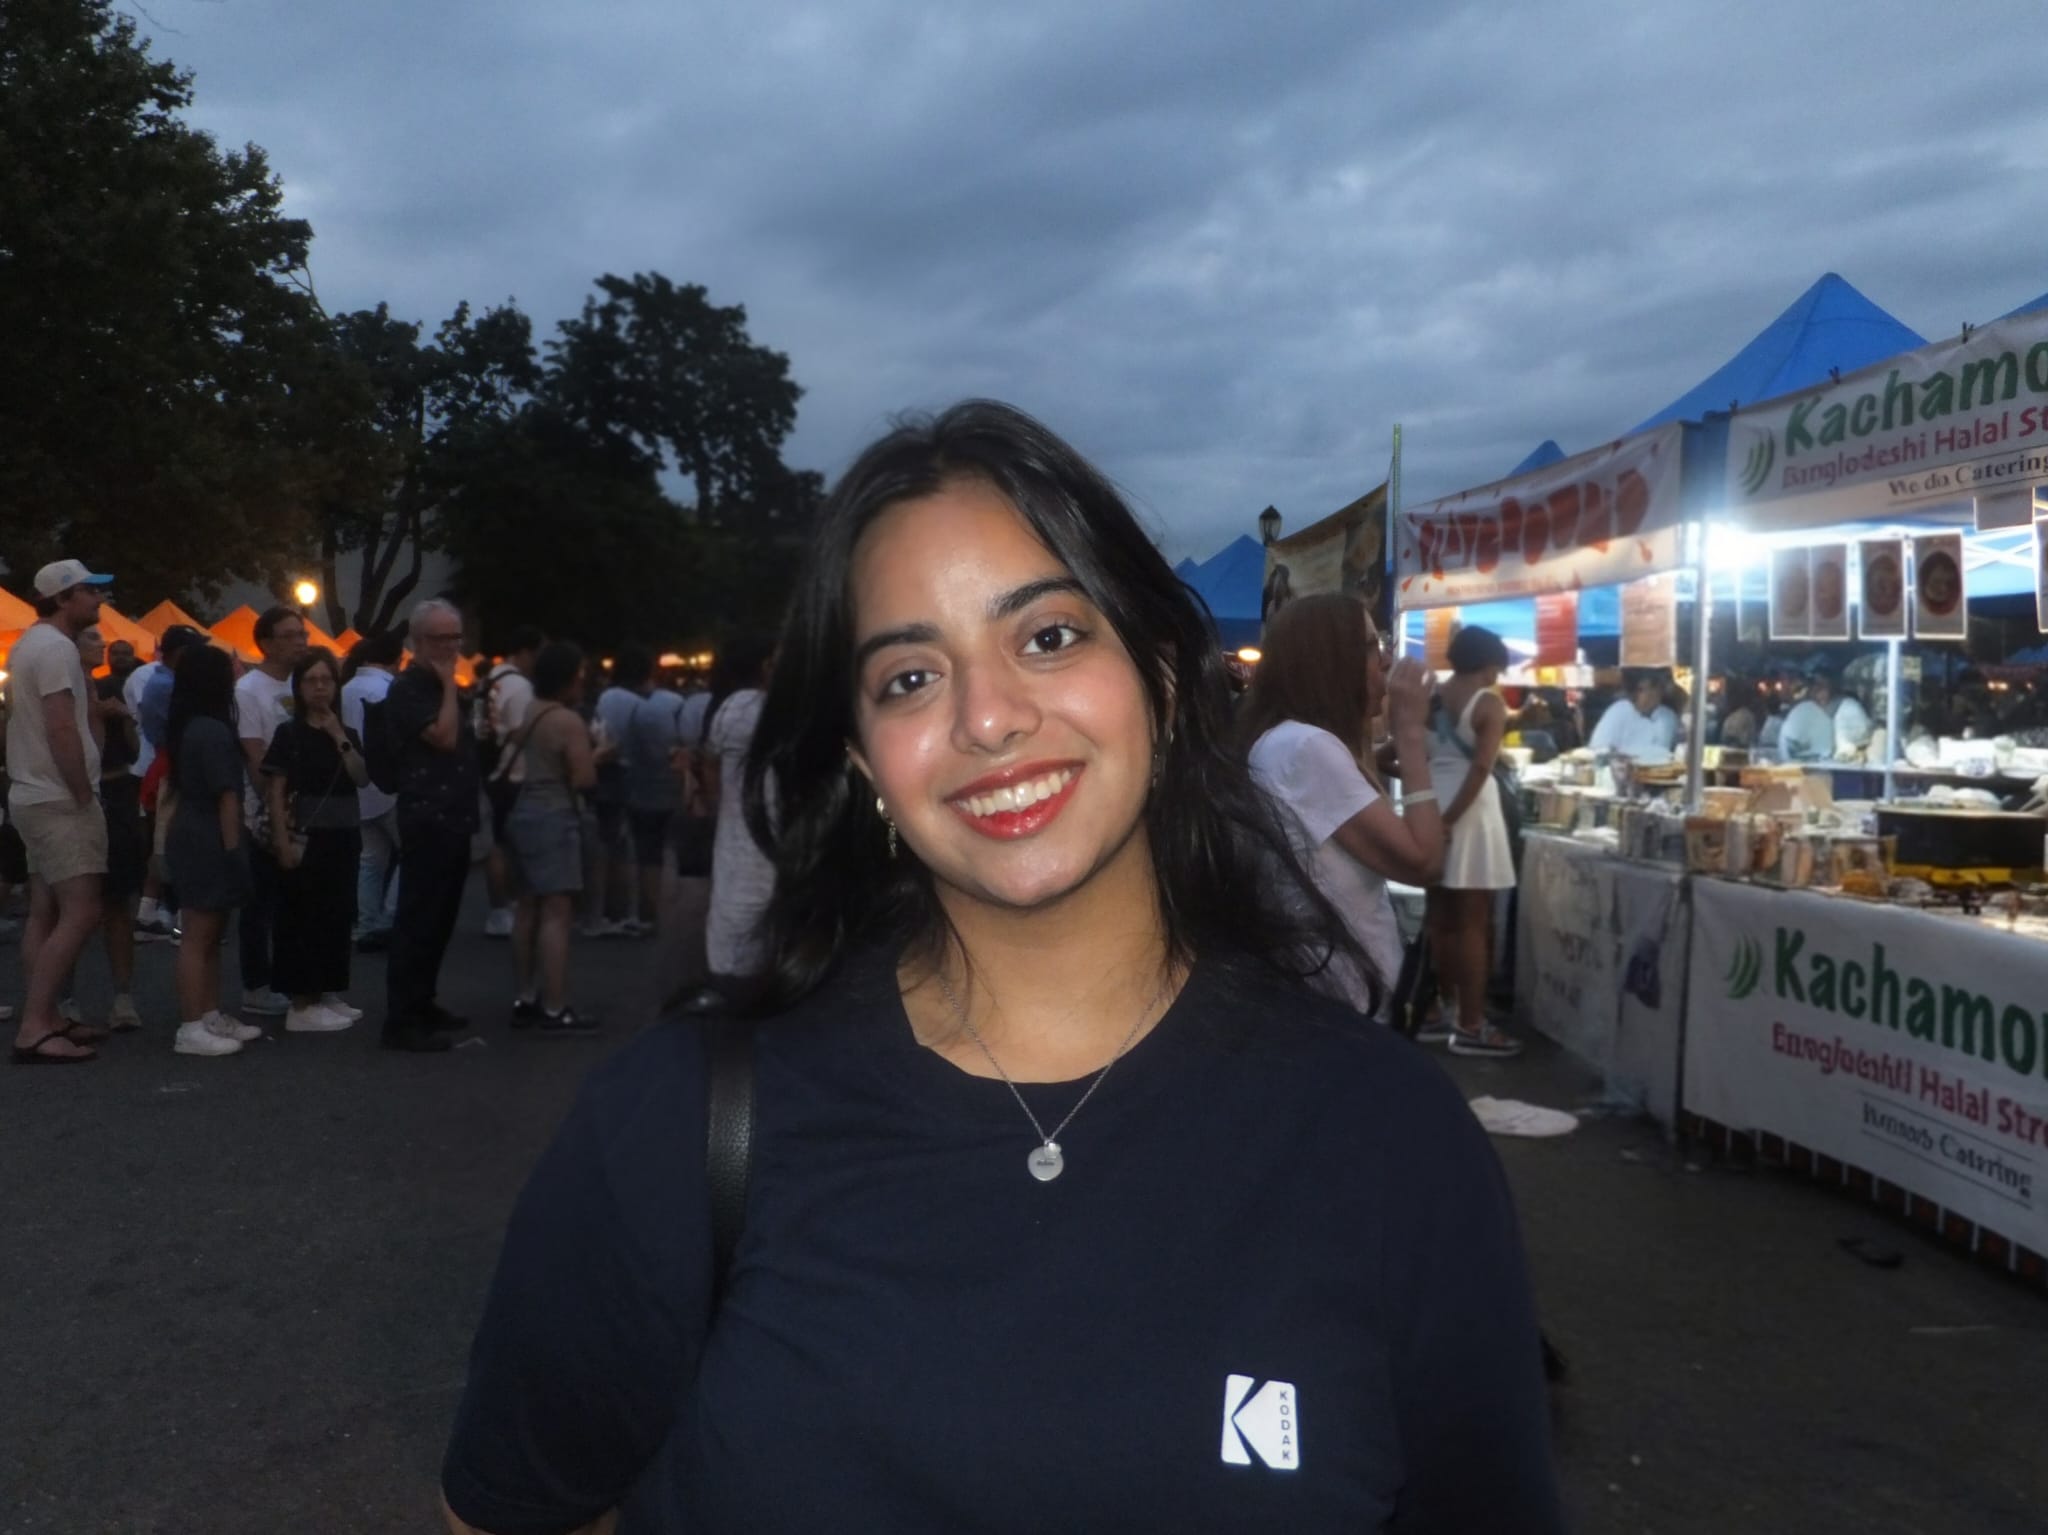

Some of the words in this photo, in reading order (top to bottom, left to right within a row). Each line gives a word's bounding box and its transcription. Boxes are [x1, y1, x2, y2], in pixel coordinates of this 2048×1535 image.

[1935, 411, 2008, 455] Halal
[1775, 926, 2048, 1080] Kachamo
[1919, 1066, 1988, 1126] Halal
[1279, 1390, 1291, 1461] KODAK
